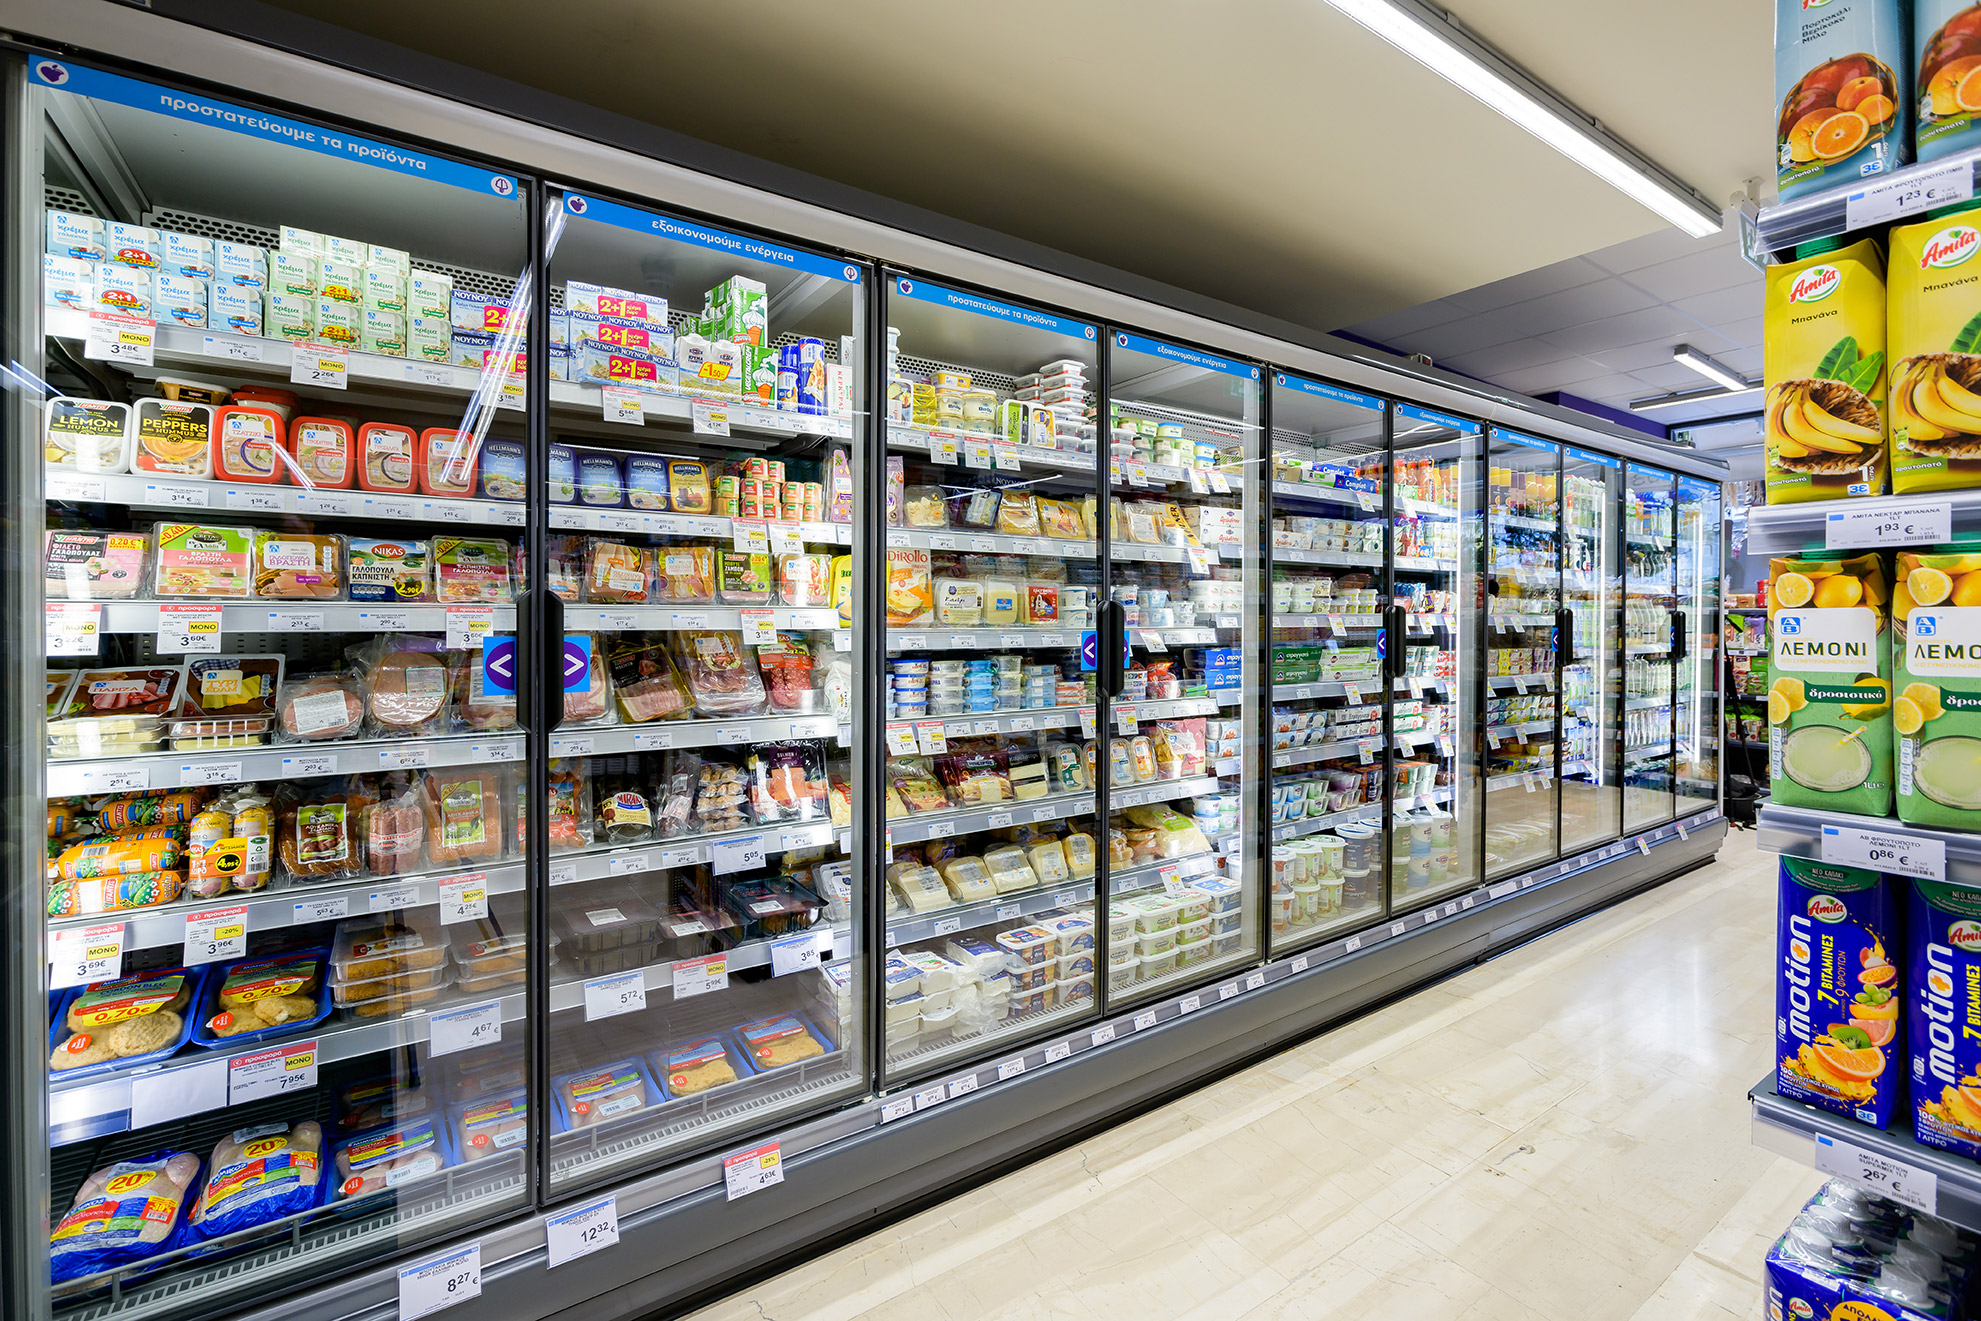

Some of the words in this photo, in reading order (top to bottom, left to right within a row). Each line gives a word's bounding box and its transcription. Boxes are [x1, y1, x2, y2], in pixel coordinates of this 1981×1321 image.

[160, 93, 314, 144] προστατεύουμε
[321, 136, 342, 150] τα
[348, 143, 427, 171] προϊόντα
[651, 220, 742, 252] εξοικονομούμε
[745, 243, 795, 264] ενέργεια
[1921, 231, 1977, 269] Amita
[1790, 270, 1837, 304] Amita
[599, 300, 626, 316] 2+1
[947, 294, 1011, 317] προστατεύουμε
[1023, 314, 1057, 328] προϊόντα
[121, 333, 150, 341] ΜΟΝΟ
[601, 328, 628, 345] 2+1
[1157, 345, 1201, 363] εξοικονομούμε
[611, 359, 637, 377] 2+1
[59, 415, 119, 428] LEMON
[67, 424, 109, 433] HUMMUS
[142, 418, 208, 432] PEPPERS
[155, 429, 195, 438] HUMMUS
[1344, 479, 1367, 491] Complet
[51, 548, 102, 556] ΓΑΛΟΠΟΥΛΑΣ
[178, 555, 233, 563] ΓΑΛΟΠΟΥΛΑ
[373, 548, 405, 556] NIKAS
[887, 550, 929, 563] DiRollo
[351, 566, 395, 574] ΓΑΛΟΠΟΥΛΑ
[351, 573, 390, 581] ΚΑΠΝΙΣΤΗ
[1780, 642, 1867, 657] ΛΕΜΟΝΙ
[1808, 687, 1882, 702] δροσιστικό
[203, 907, 241, 918] προσφορά
[1808, 901, 1844, 917] Amita
[88, 945, 118, 956] ΜΟΝΟ
[1785, 914, 1812, 1043] motion
[140, 981, 167, 991] BLEU
[1921, 942, 1956, 1087] motion
[244, 1051, 283, 1066] προσφορά
[285, 1057, 311, 1069] ΜΟΝΟ
